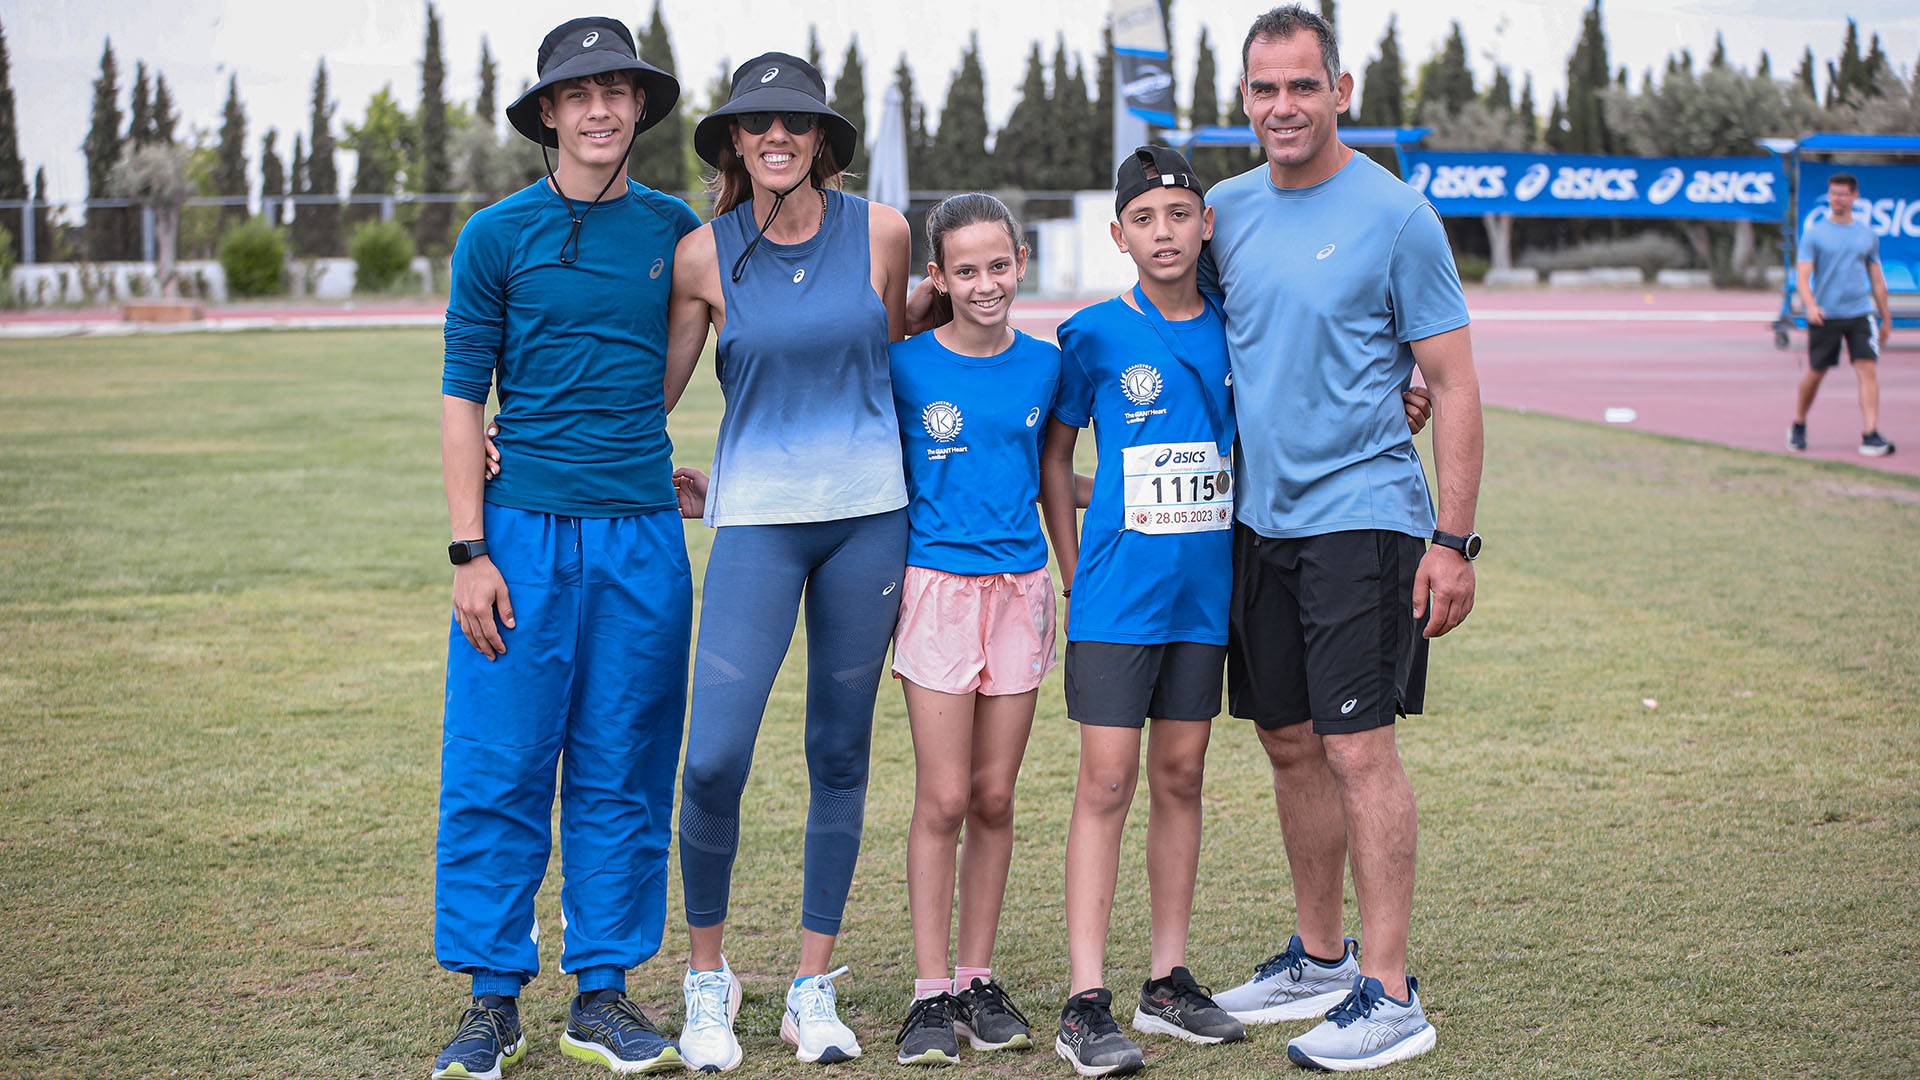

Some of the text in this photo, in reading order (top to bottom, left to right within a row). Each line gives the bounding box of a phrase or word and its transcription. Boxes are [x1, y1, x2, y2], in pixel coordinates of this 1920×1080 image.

[1430, 165, 1776, 204] asics asics asics
[1173, 451, 1206, 464] asics
[1152, 476, 1215, 503] 1115
[1156, 510, 1213, 524] 28.05.2023
